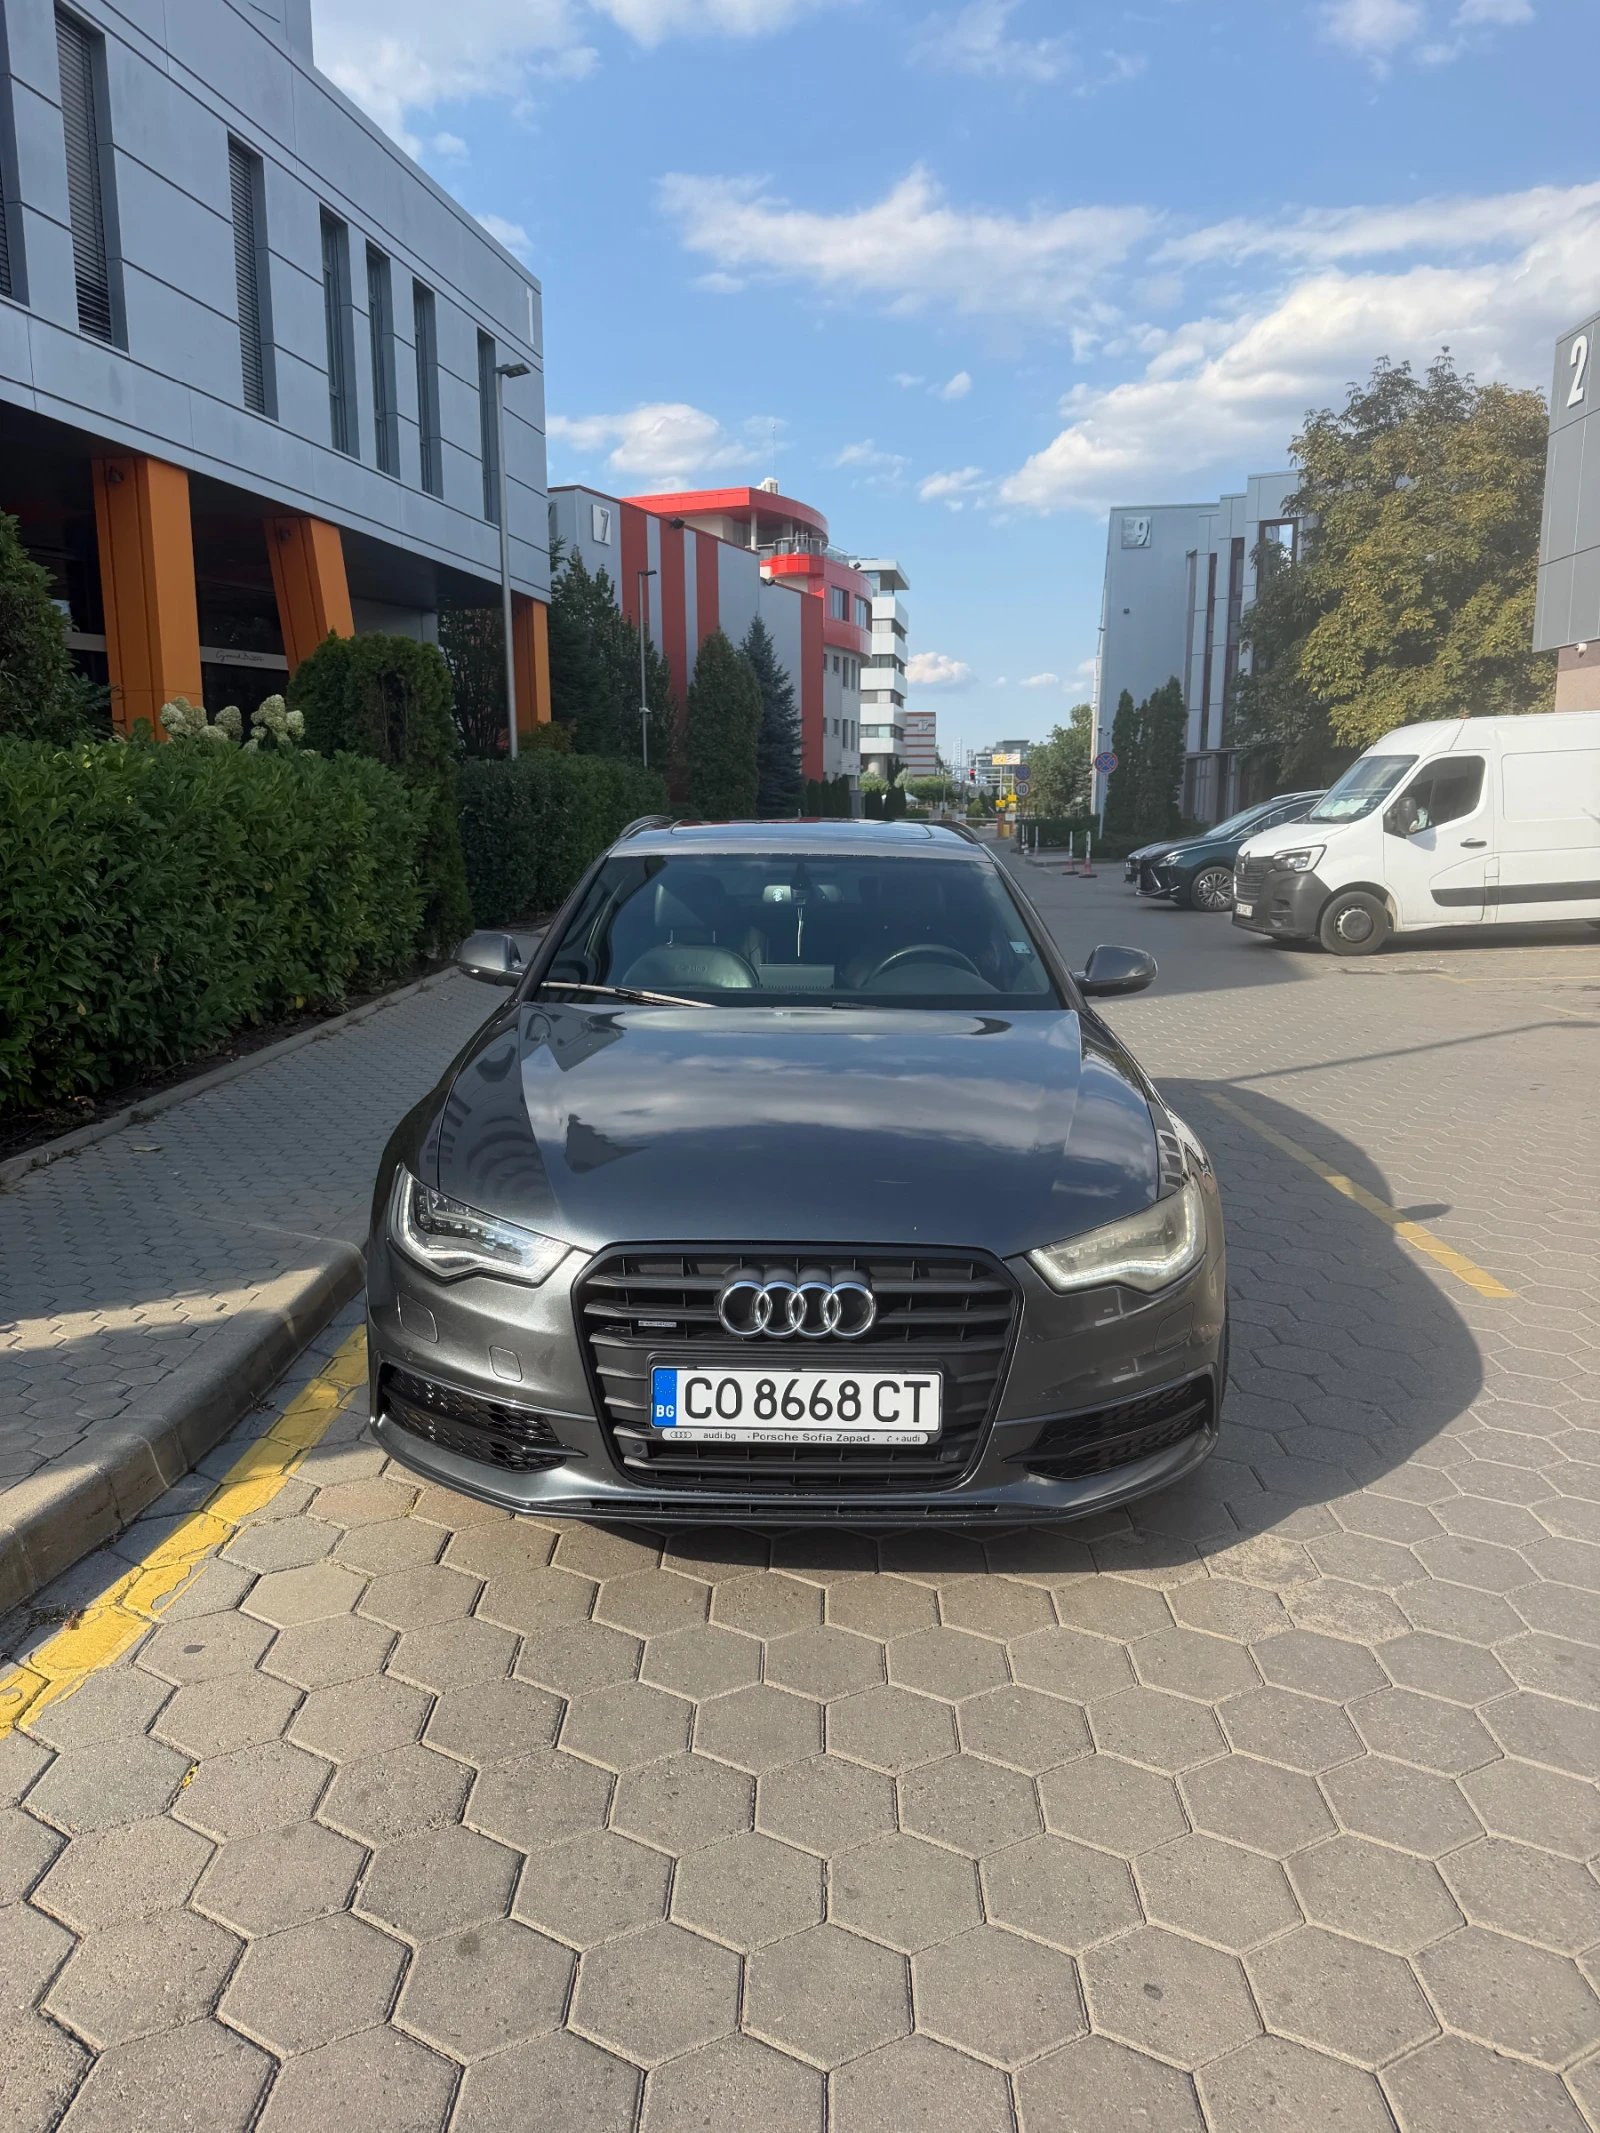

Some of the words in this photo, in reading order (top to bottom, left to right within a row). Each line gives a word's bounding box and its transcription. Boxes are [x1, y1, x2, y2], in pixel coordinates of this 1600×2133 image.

[1566, 334, 1588, 410] 2
[600, 508, 609, 541] 7
[1134, 519, 1149, 546] 9
[1018, 785, 1028, 794] 10
[656, 1405, 675, 1418] BG
[684, 1377, 743, 1419] CO
[753, 1378, 861, 1421] 8668
[873, 1380, 931, 1423] CT
[703, 1432, 736, 1440] audi.bg
[752, 1432, 798, 1441] Porsche
[802, 1433, 833, 1442] Sofia
[836, 1434, 870, 1443] Zapad
